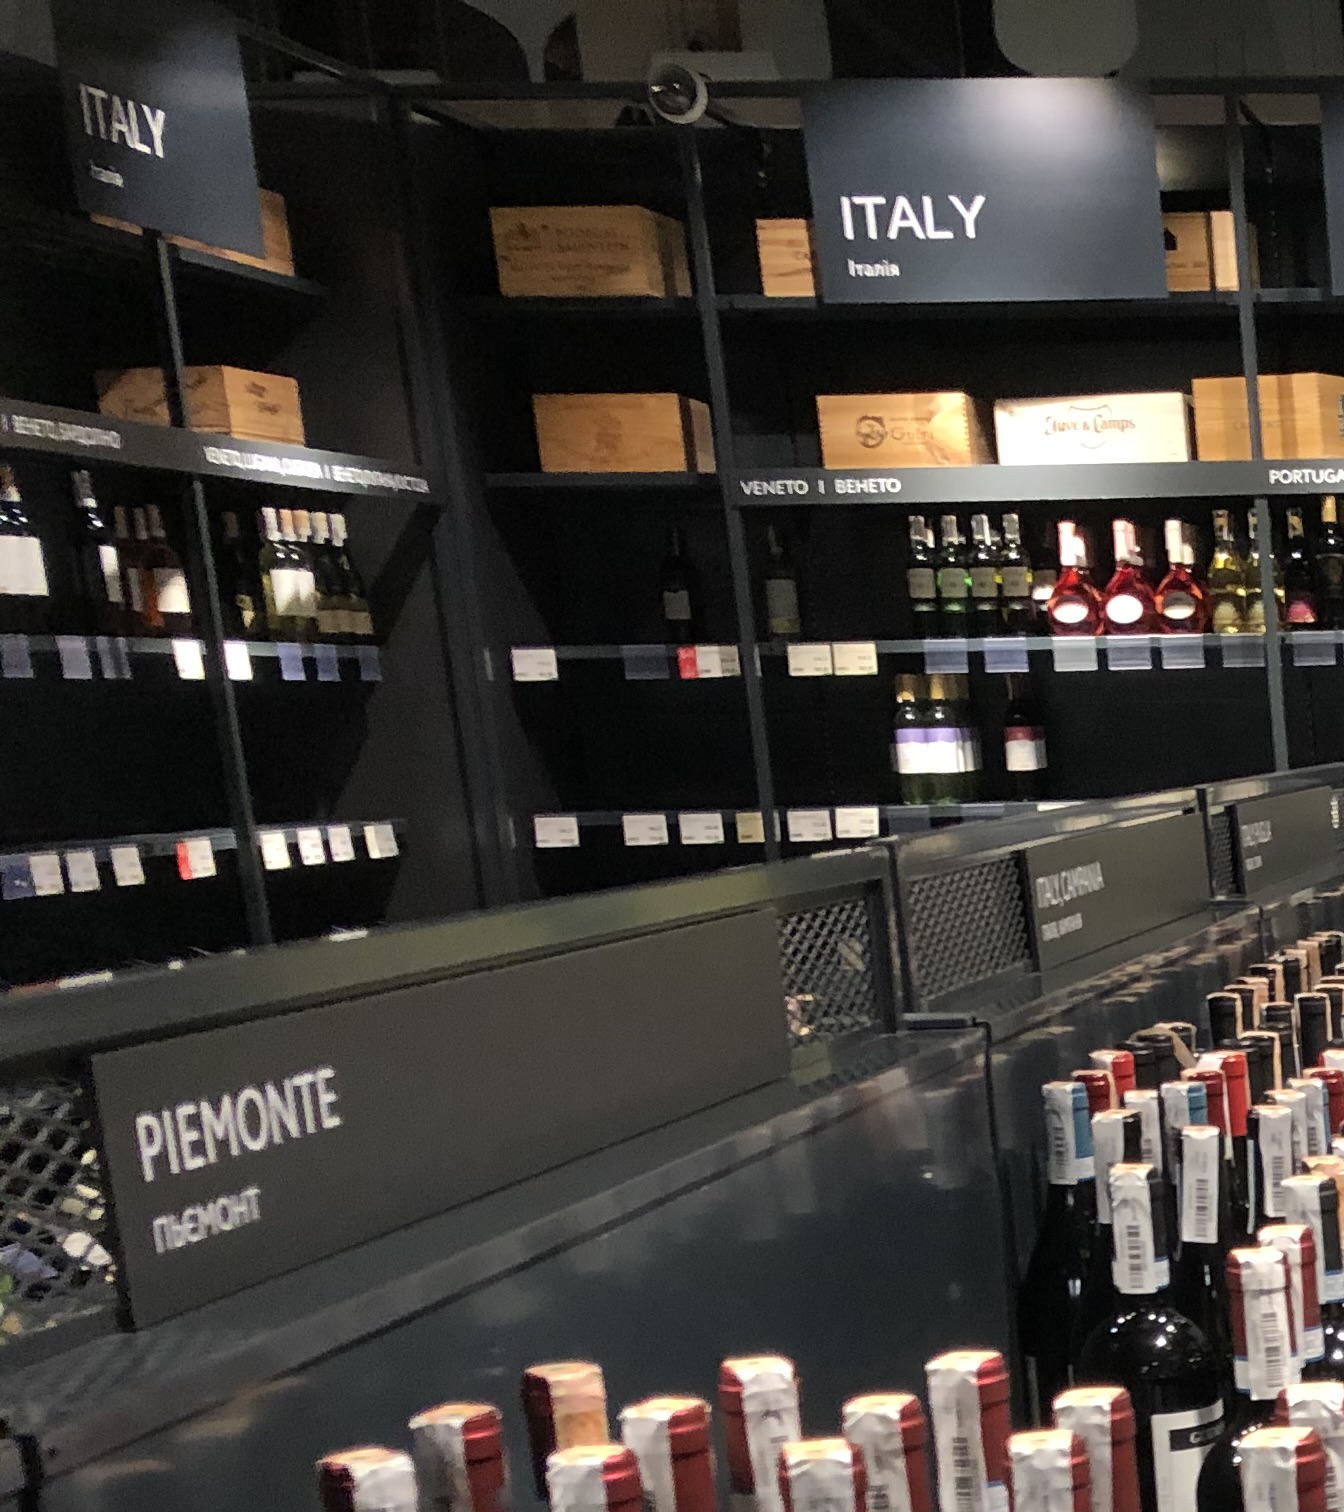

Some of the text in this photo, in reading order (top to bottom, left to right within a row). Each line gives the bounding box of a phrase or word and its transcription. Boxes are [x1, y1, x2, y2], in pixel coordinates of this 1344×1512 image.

[80, 83, 166, 158] ITALY
[841, 195, 985, 239] ITALY
[848, 259, 899, 277] Італія
[740, 480, 808, 495] VENETO
[836, 478, 901, 493] ВЕНЕТО
[136, 1067, 343, 1182] PIEMONTE
